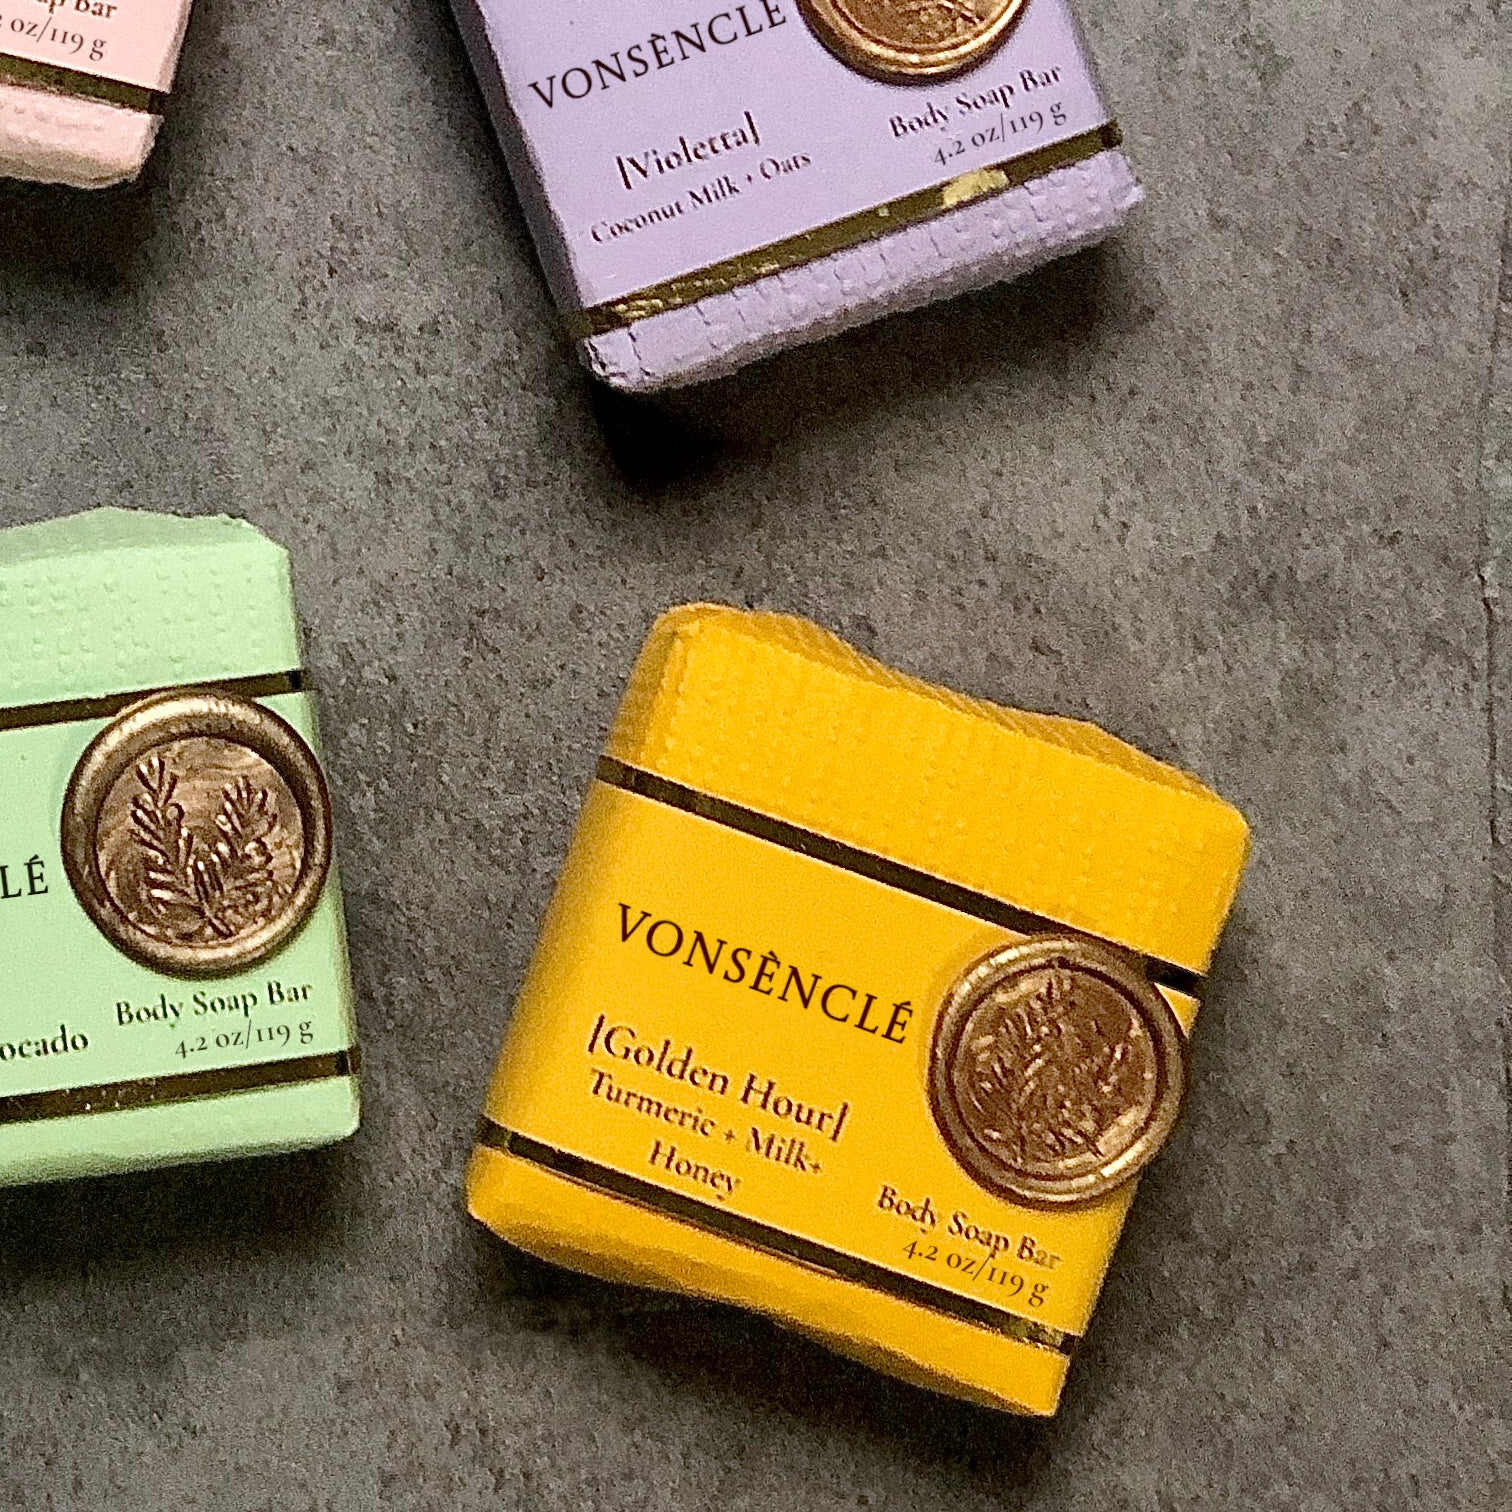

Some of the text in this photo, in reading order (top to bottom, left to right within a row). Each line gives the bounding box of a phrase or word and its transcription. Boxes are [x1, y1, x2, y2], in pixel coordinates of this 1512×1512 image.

[10, 18, 82, 57] oz/119
[89, 36, 107, 62] g
[889, 63, 1062, 140] Body Soap Bar
[933, 100, 1068, 167] 4.2 oz/119 g
[590, 204, 685, 246] Coconut
[687, 176, 741, 213] Milk
[760, 152, 813, 181] Oats
[115, 980, 313, 1028] Body Soap Bar
[617, 903, 913, 1046] VONSÈNCLÉ
[173, 1018, 314, 1060] 4.2 oz/119 g
[588, 1067, 717, 1138] Turmeric
[648, 1139, 741, 1201] Honey
[876, 1183, 1061, 1270] Body Soap Bar
[901, 1237, 1049, 1308] 4.2 oz/119 g
